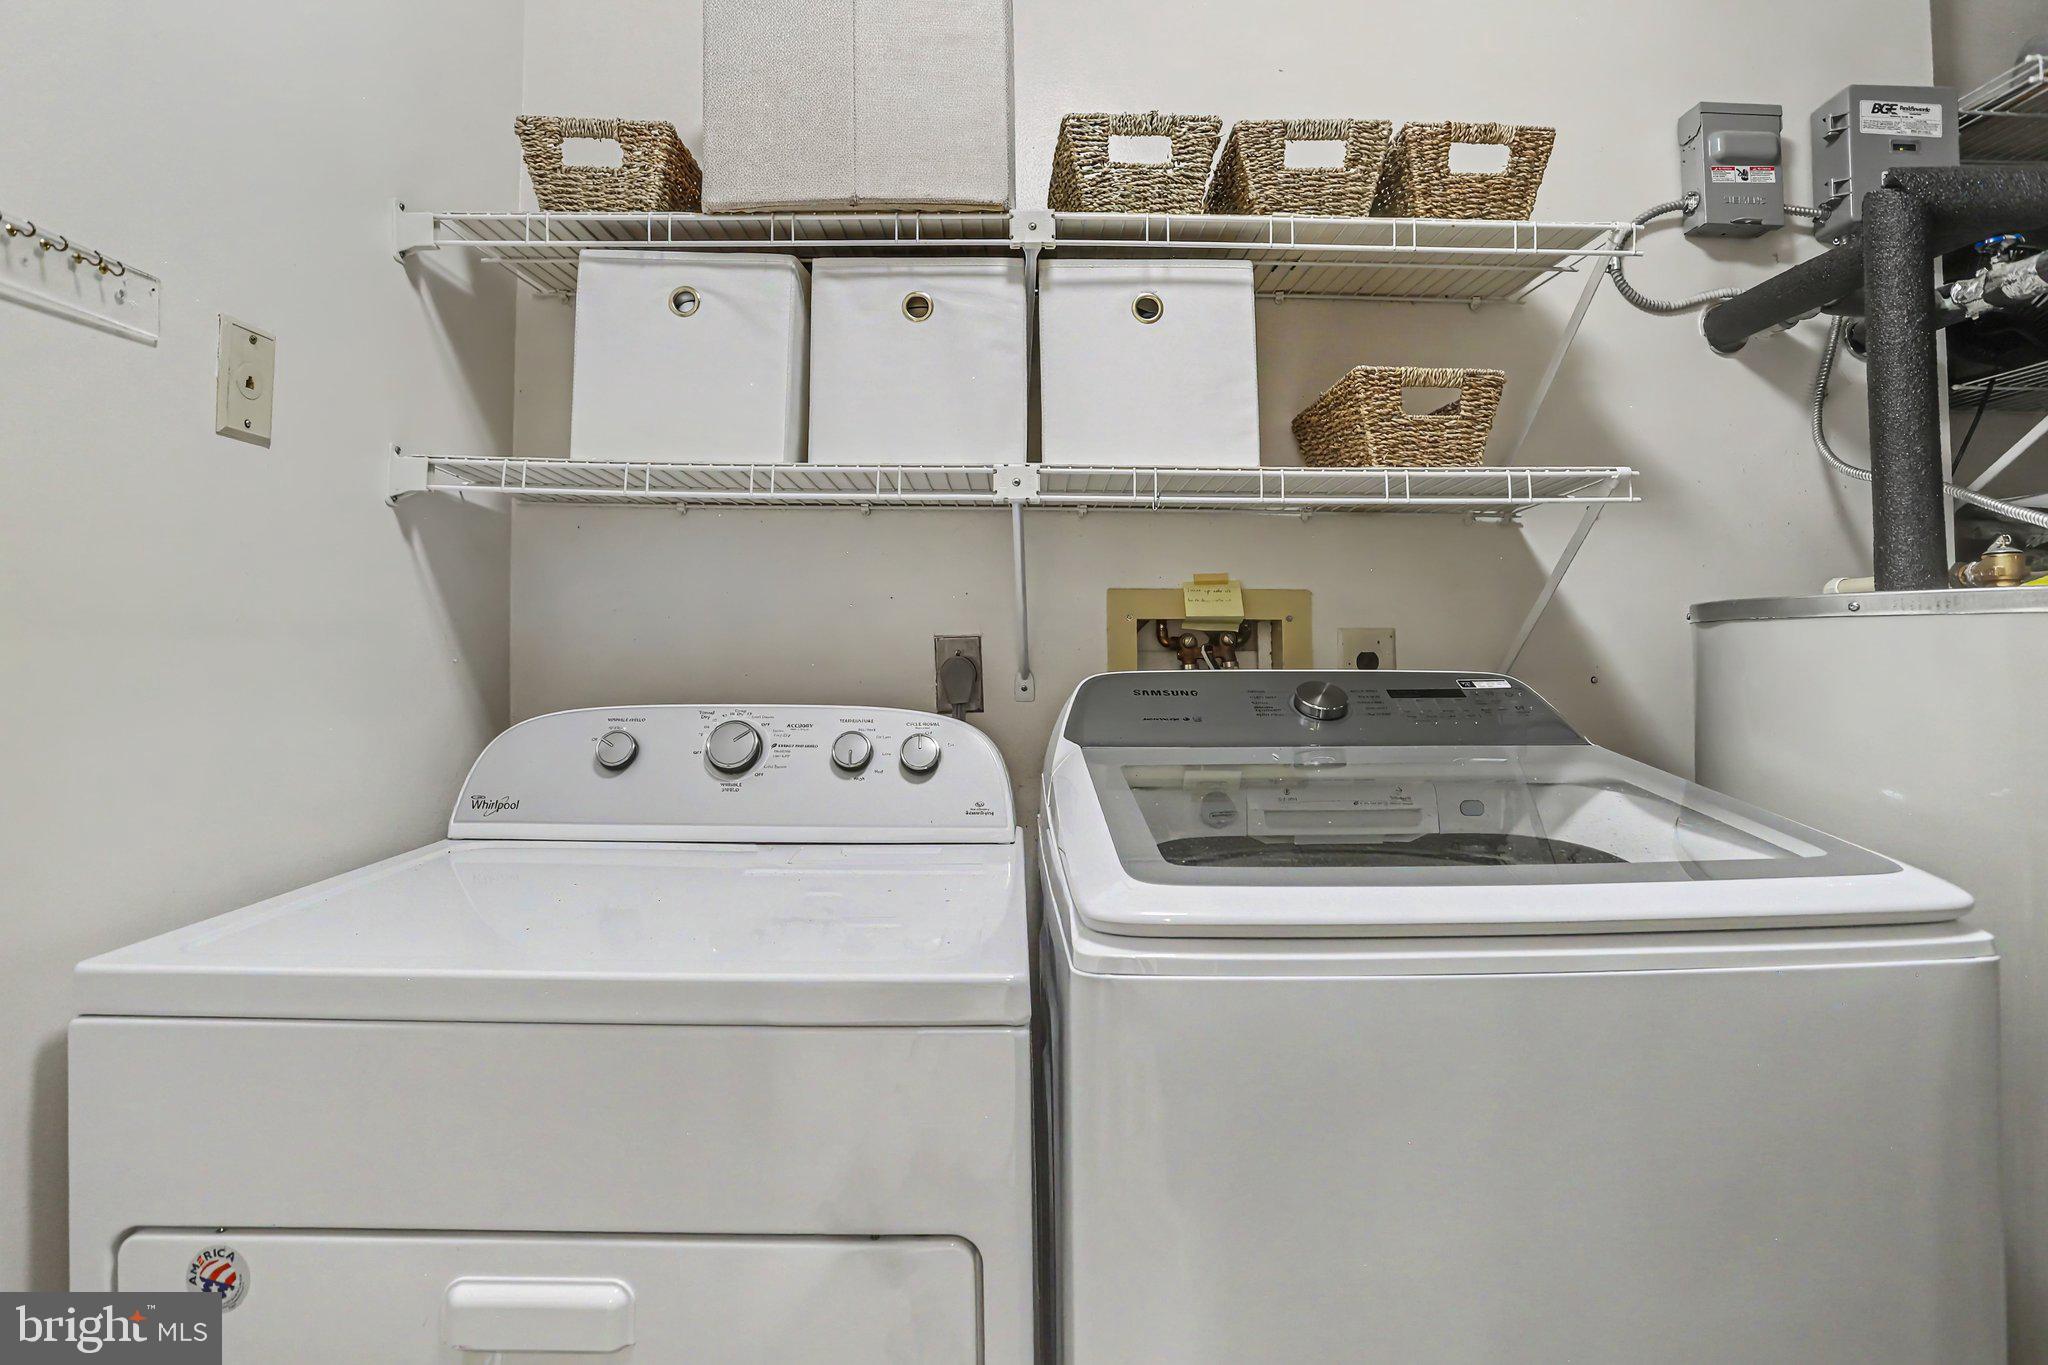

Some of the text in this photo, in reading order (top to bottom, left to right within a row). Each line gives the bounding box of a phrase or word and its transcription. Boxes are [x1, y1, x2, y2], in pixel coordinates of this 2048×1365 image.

[1871, 103, 1898, 115] BGE
[1133, 689, 1199, 697] SAMSUNG
[471, 798, 520, 814] Whirlpool
[189, 1249, 235, 1286] AMERICA
